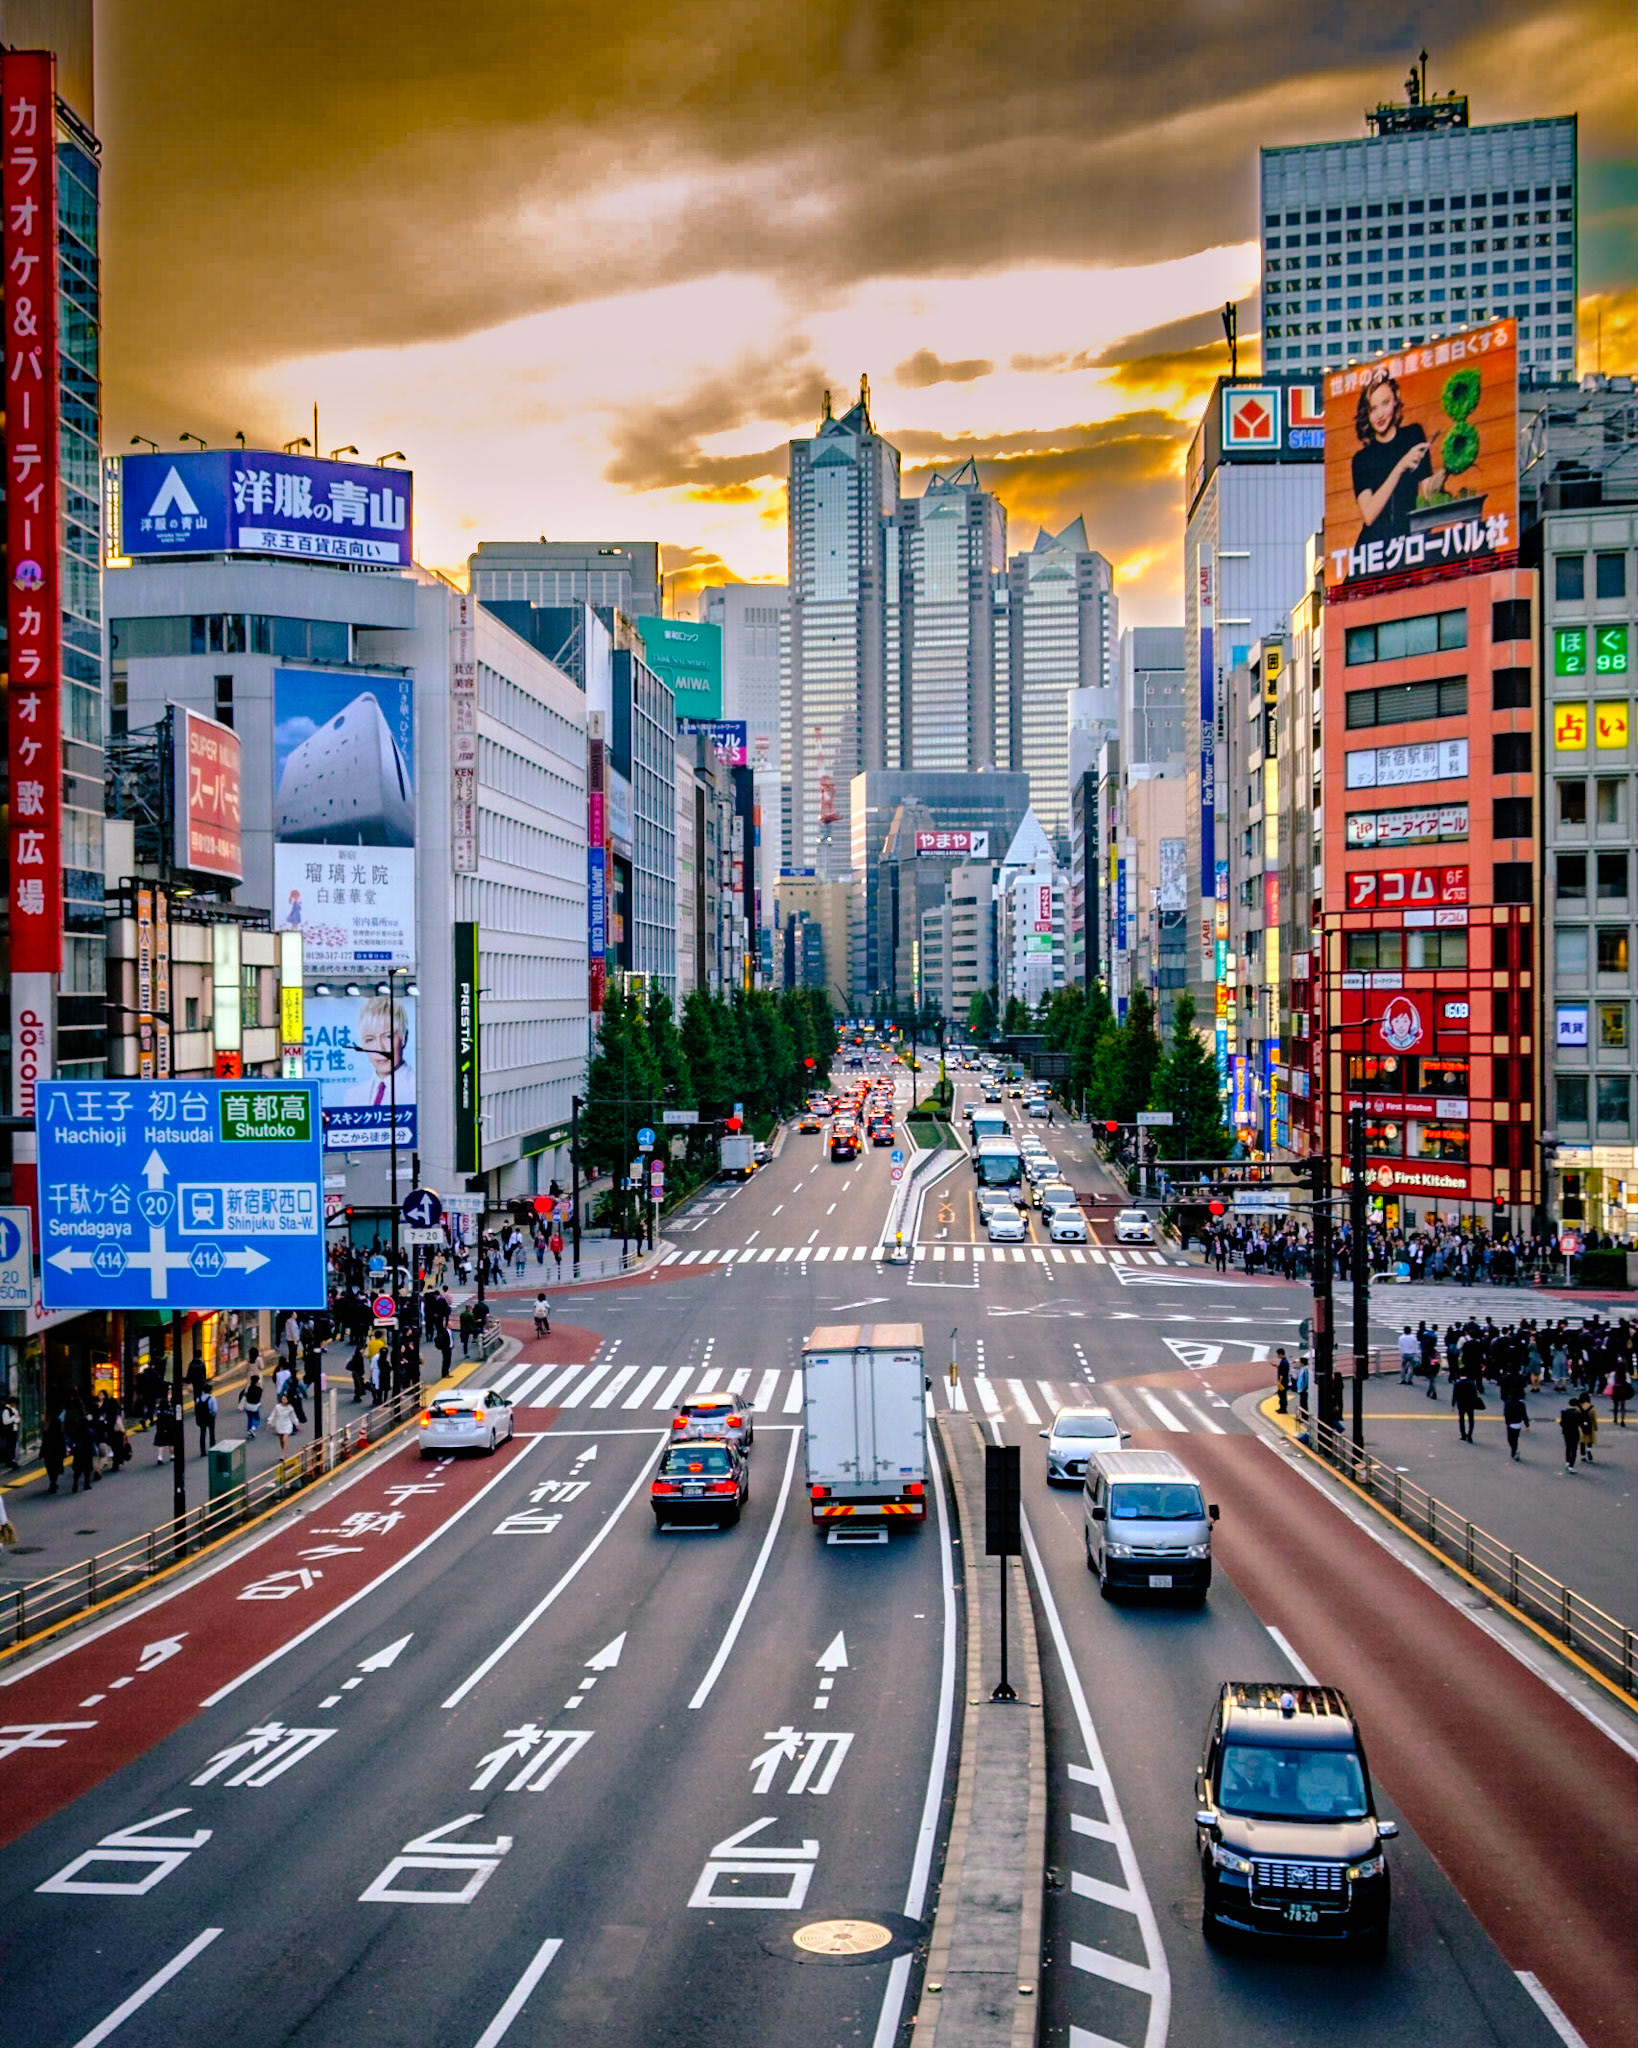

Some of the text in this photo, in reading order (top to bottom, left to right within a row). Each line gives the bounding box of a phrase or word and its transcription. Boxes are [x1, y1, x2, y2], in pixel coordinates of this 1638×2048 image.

[9, 97, 45, 550] カラオケ&パーティー
[232, 469, 405, 531] 洋服の青山
[141, 516, 208, 532] 洋服の青山
[261, 532, 381, 557] 京王百貨店向い
[1332, 513, 1509, 579] THEグローバル社
[675, 676, 710, 691] MIWA
[1558, 714, 1625, 743] 占い
[16, 604, 45, 916] カラオケ歌広場
[1379, 745, 1435, 767] 新宿駅前
[1449, 743, 1459, 773] 歯科
[454, 769, 474, 777] KEN
[1202, 762, 1213, 785] Your
[1358, 766, 1439, 785] デンタルクリニック
[1203, 786, 1213, 805] For
[1379, 817, 1467, 838] エーアイアール
[920, 834, 967, 849] やまや
[338, 850, 356, 860] 新宿
[305, 863, 388, 885] 瑠璃光院
[592, 866, 603, 896] JAPAN
[1446, 870, 1463, 884] 6F
[317, 887, 376, 905] 白蓮華堂
[1354, 871, 1434, 904] アコム
[592, 898, 603, 925] TOTAL
[1439, 912, 1464, 922] アコム
[592, 927, 603, 952] CLUB
[1202, 920, 1210, 946] LABI
[284, 1047, 301, 1056] KM
[47, 1091, 305, 1122] 八王子 初台 首都高
[331, 1111, 412, 1126] スキンクリニック
[55, 1123, 295, 1146] Hachioji Hatsudai Shutoko
[331, 1131, 406, 1144] ここから徒歩分
[1395, 1172, 1421, 1185] First
[1422, 1175, 1466, 1188] Kitchen
[146, 1197, 168, 1216] 20
[226, 1188, 312, 1214] 新宿駅西口
[50, 1220, 132, 1238] Sendagaya
[228, 1215, 314, 1232] Shinjuku Sta.-W.
[411, 1231, 438, 1241] 7-20
[97, 1252, 121, 1267] 414
[194, 1252, 219, 1267] 414
[492, 1480, 591, 1535] 初台
[34, 1722, 338, 1895] 初台
[358, 1724, 594, 1904] 初台
[688, 1727, 854, 1909] 初台
[1289, 1910, 1318, 1922] 78-20
